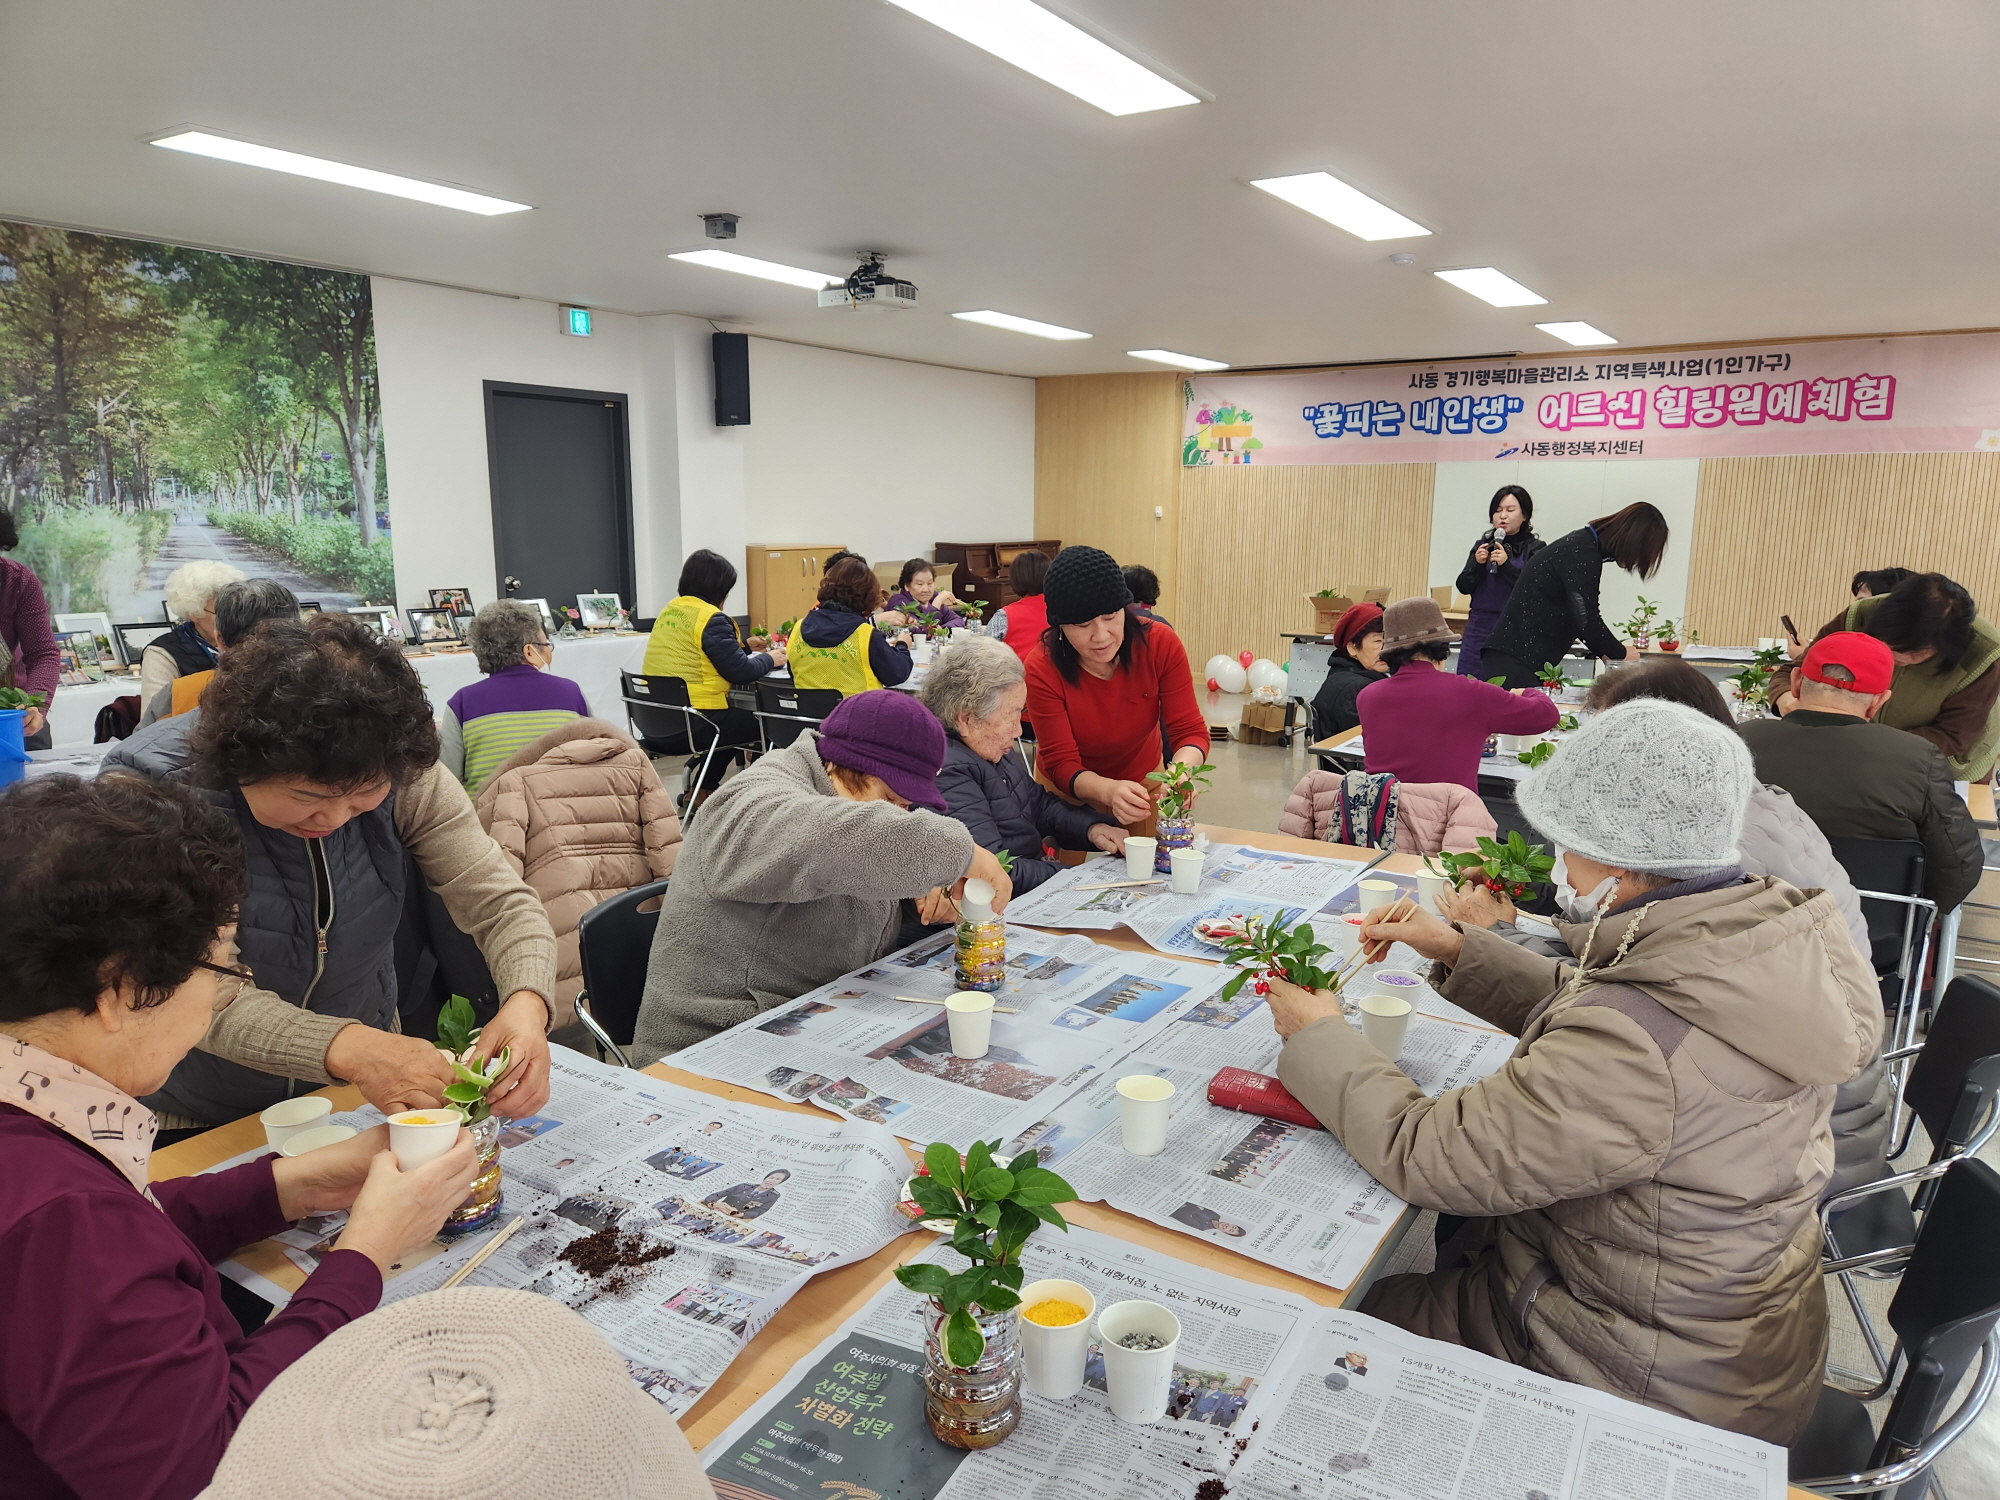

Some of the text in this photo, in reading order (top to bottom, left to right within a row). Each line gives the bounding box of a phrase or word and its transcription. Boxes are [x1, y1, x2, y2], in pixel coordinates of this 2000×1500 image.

[1408, 353, 1791, 389] 사동 경기행복마을관리소 지역특색사업(1인가구)
[1303, 400, 1405, 438] "꽃피는
[1409, 394, 1524, 434] 내인생"
[1537, 388, 1647, 431] 어르신
[1521, 439, 1644, 456] 사동행정복지센터
[1125, 1252, 1146, 1264] 투데이
[1061, 1252, 1075, 1262] 노
[1076, 1256, 1099, 1273] 젓는
[1101, 1266, 1147, 1289] 대형서점,
[1150, 1283, 1165, 1294] 노
[1166, 1288, 1191, 1303] 없는
[1192, 1296, 1242, 1318] 지역서점
[849, 1346, 899, 1369] 여주시의회
[896, 1363, 920, 1374] 의정
[832, 1361, 888, 1391] 여주쌀
[1400, 1356, 1433, 1371] 15개월
[1436, 1364, 1458, 1380] 남은
[1461, 1374, 1493, 1391] 수도권
[1530, 1397, 1577, 1417] 시한폭탄
[1515, 1377, 1552, 1394] 오피니언
[814, 1379, 887, 1412] 산업특구
[794, 1396, 894, 1440] 차별화 전략
[1755, 1450, 1768, 1461] 19
